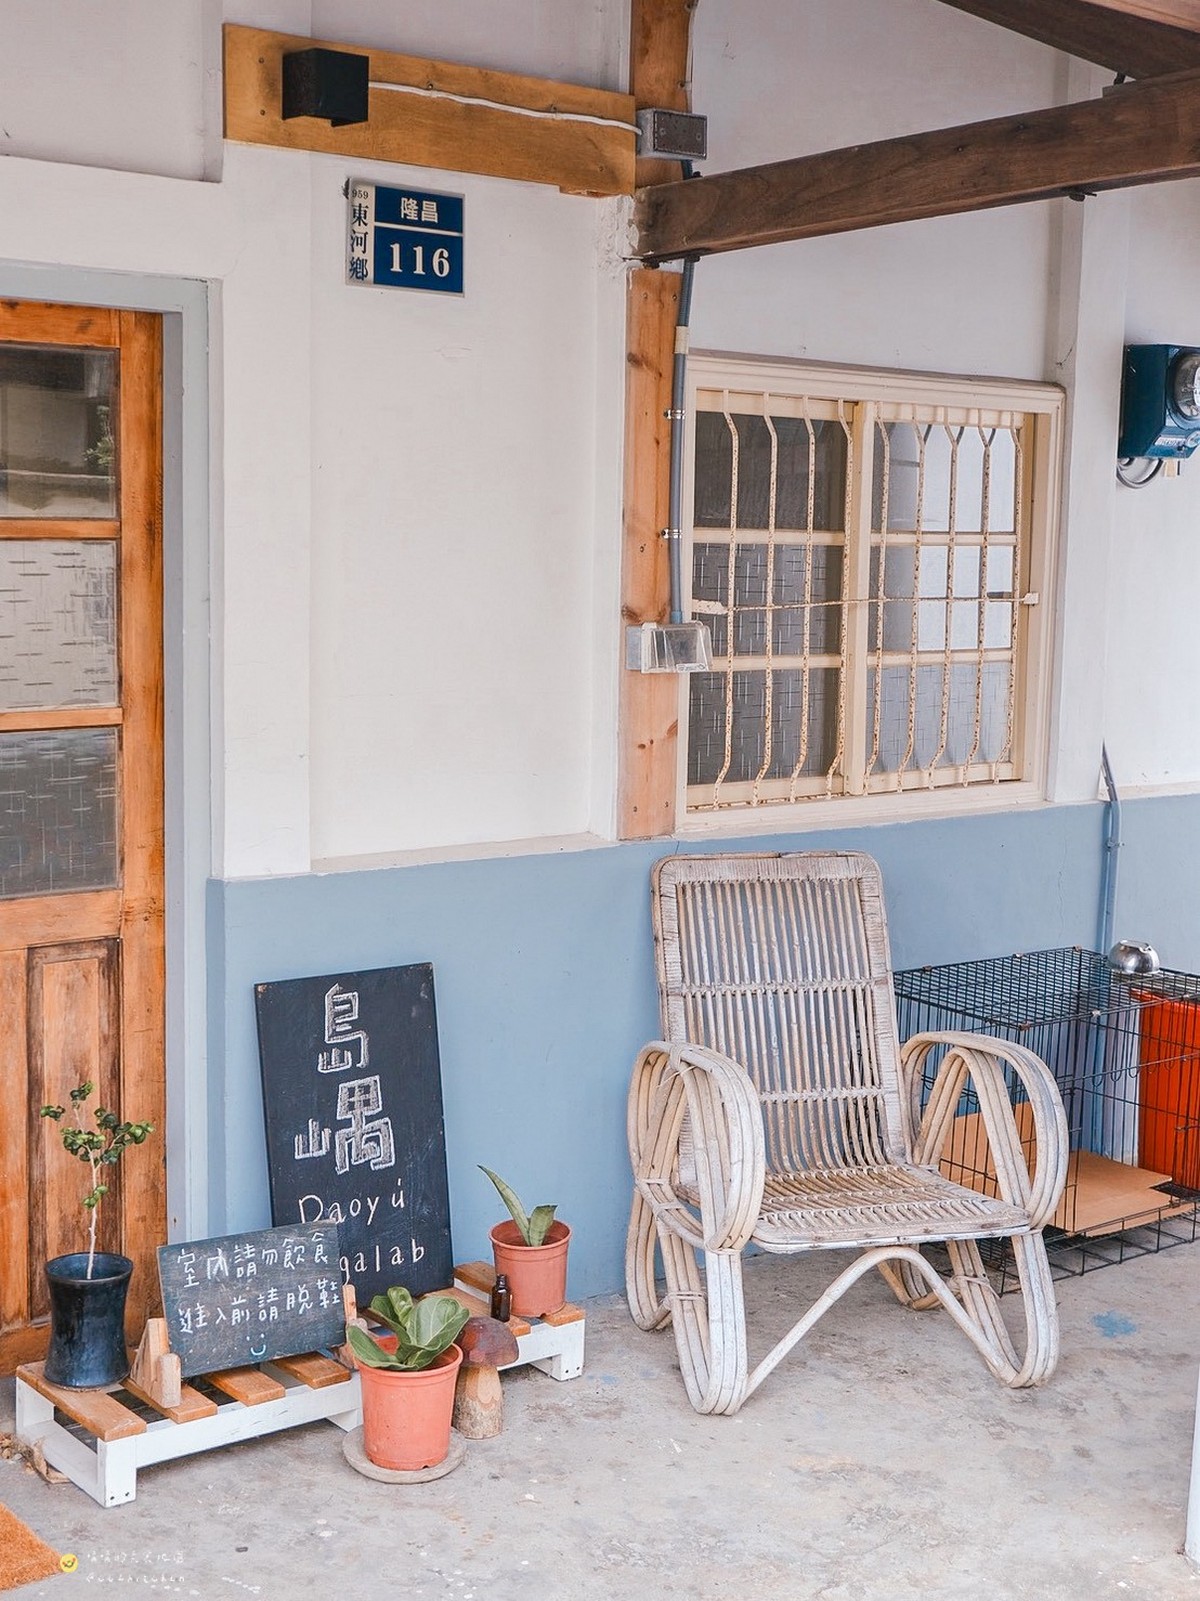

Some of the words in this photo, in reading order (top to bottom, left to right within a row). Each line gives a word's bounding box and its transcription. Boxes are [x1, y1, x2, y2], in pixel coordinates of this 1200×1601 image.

[351, 188, 369, 200] 959
[400, 197, 438, 223] 隆昌
[349, 203, 369, 281] 東河鄉
[390, 242, 450, 278] 116
